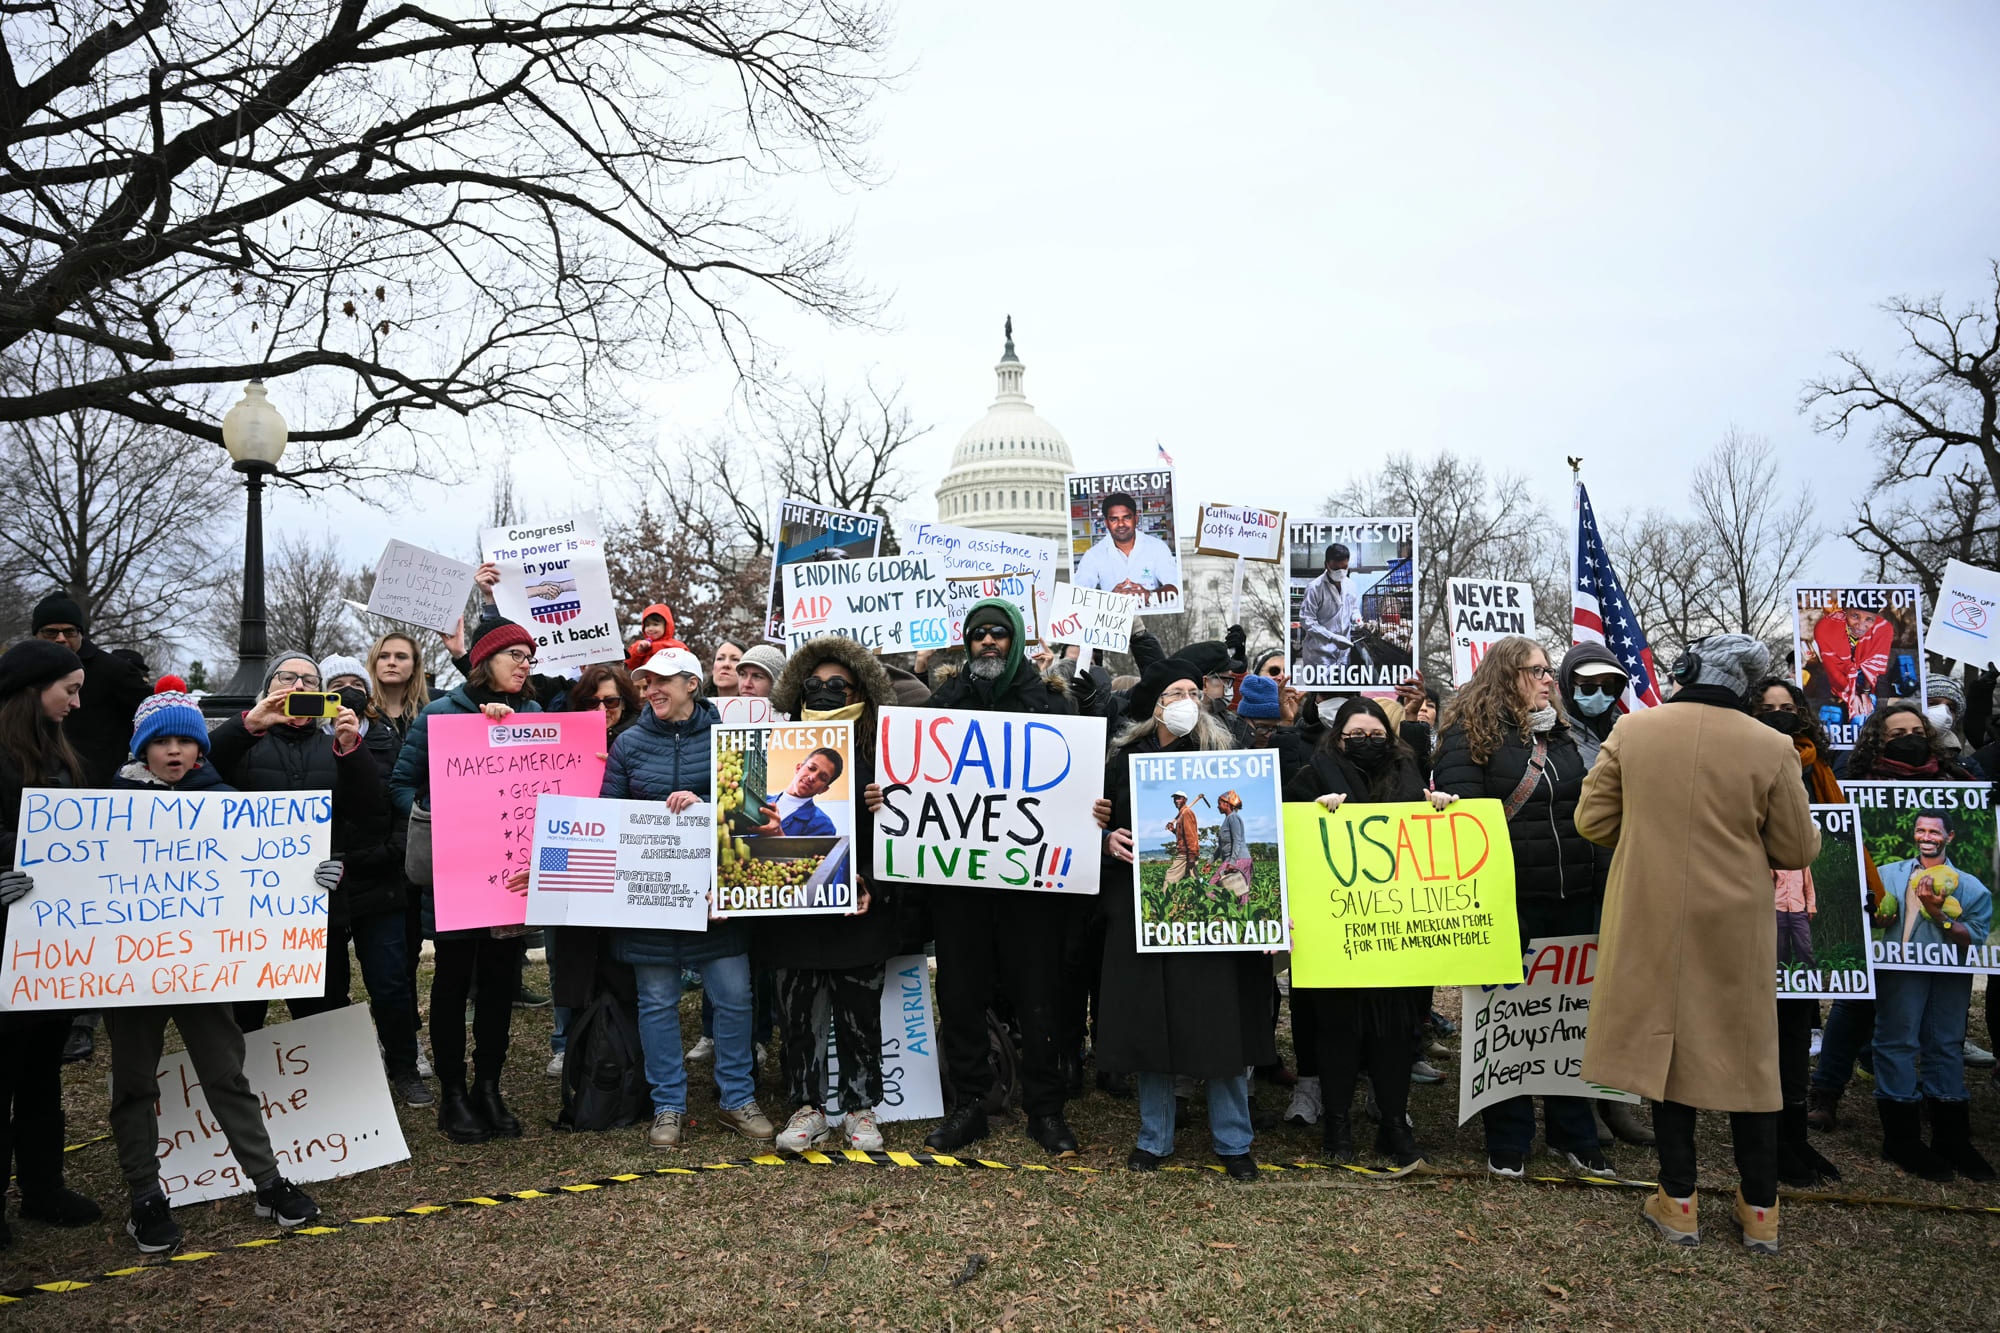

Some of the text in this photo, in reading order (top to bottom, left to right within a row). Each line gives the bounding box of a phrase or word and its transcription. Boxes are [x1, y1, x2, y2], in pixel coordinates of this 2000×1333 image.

[1070, 472, 1170, 495] THE FACES OF
[509, 520, 575, 541] Congress!
[783, 505, 876, 537] THE FACES OF
[1243, 512, 1277, 528] USAID
[1291, 524, 1412, 543] THE FACES OF
[493, 550, 517, 560] The
[522, 542, 562, 559] power
[567, 540, 577, 549] is
[968, 540, 1031, 558] assistance
[1039, 550, 1048, 561] is
[524, 559, 570, 575] in your
[794, 559, 935, 588] ENDING GLOBAL
[407, 574, 452, 596] USAID
[949, 581, 980, 599] SAVE
[983, 578, 1024, 597] USAID
[1453, 584, 1520, 607] NEVER
[1952, 590, 1976, 602] HANDS
[379, 603, 403, 615] YOUR
[792, 589, 947, 620] AID WON'T FIX
[1150, 592, 1178, 608] AID
[1798, 590, 1915, 609] THE FACES OF
[910, 618, 947, 643] EGGS
[1052, 612, 1125, 638] NOT MUSK
[1456, 609, 1525, 634] AGAIN
[552, 631, 564, 644] it
[569, 623, 610, 641] back!
[1457, 637, 1470, 646] is
[1292, 665, 1411, 684] FOREIGN AID
[512, 728, 557, 738] USAID
[718, 728, 847, 751] THE FACES OF
[447, 753, 582, 777] MAKES AMERICA:
[881, 715, 1072, 793] USAID
[1137, 756, 1271, 781] THE FACES OF
[510, 780, 562, 799] GREAT
[1845, 788, 1991, 810] THE FACES OF
[27, 794, 331, 833] BOTH MY PARENTS
[630, 814, 711, 827] SAVES LIVES
[880, 783, 1044, 846] SAVES
[1826, 811, 1851, 832] OF
[549, 820, 605, 836] USAID
[620, 834, 681, 845] PROTECTS
[21, 834, 312, 866] LOST THEIR JOBS
[641, 848, 711, 859] AMERICANS
[1319, 812, 1489, 887] USAID
[886, 839, 1072, 888] LIVES!!!
[98, 869, 280, 895] THANKS TO
[616, 870, 671, 882] FOSTERS
[628, 882, 690, 894] GOODWILL
[719, 883, 849, 909] FOREIGN AID
[1331, 878, 1480, 919] SAVES LIVES!
[30, 893, 328, 929] PRESIDENT MUSK
[627, 895, 694, 908] STABILITY
[1144, 920, 1281, 946] FOREIGN AID
[1345, 913, 1494, 938] FROM THE AMERICAN PEOPLE
[12, 927, 327, 971] HOW DOES THIS MAKE
[1354, 940, 1373, 954] FOR
[1377, 937, 1398, 951] THE
[1401, 934, 1451, 950] AMERICAN
[1453, 930, 1491, 946] PEOPLE
[1873, 941, 1958, 966] OREIGN
[11, 960, 322, 1005] AMERICA GREAT AGAIN
[1776, 970, 1867, 992] EIGN AID
[898, 965, 929, 1056] AMERICA
[1493, 994, 1591, 1022] Saves live
[1492, 1024, 1549, 1053] Buys
[272, 1042, 309, 1075] is
[1488, 1058, 1545, 1089] Keeps
